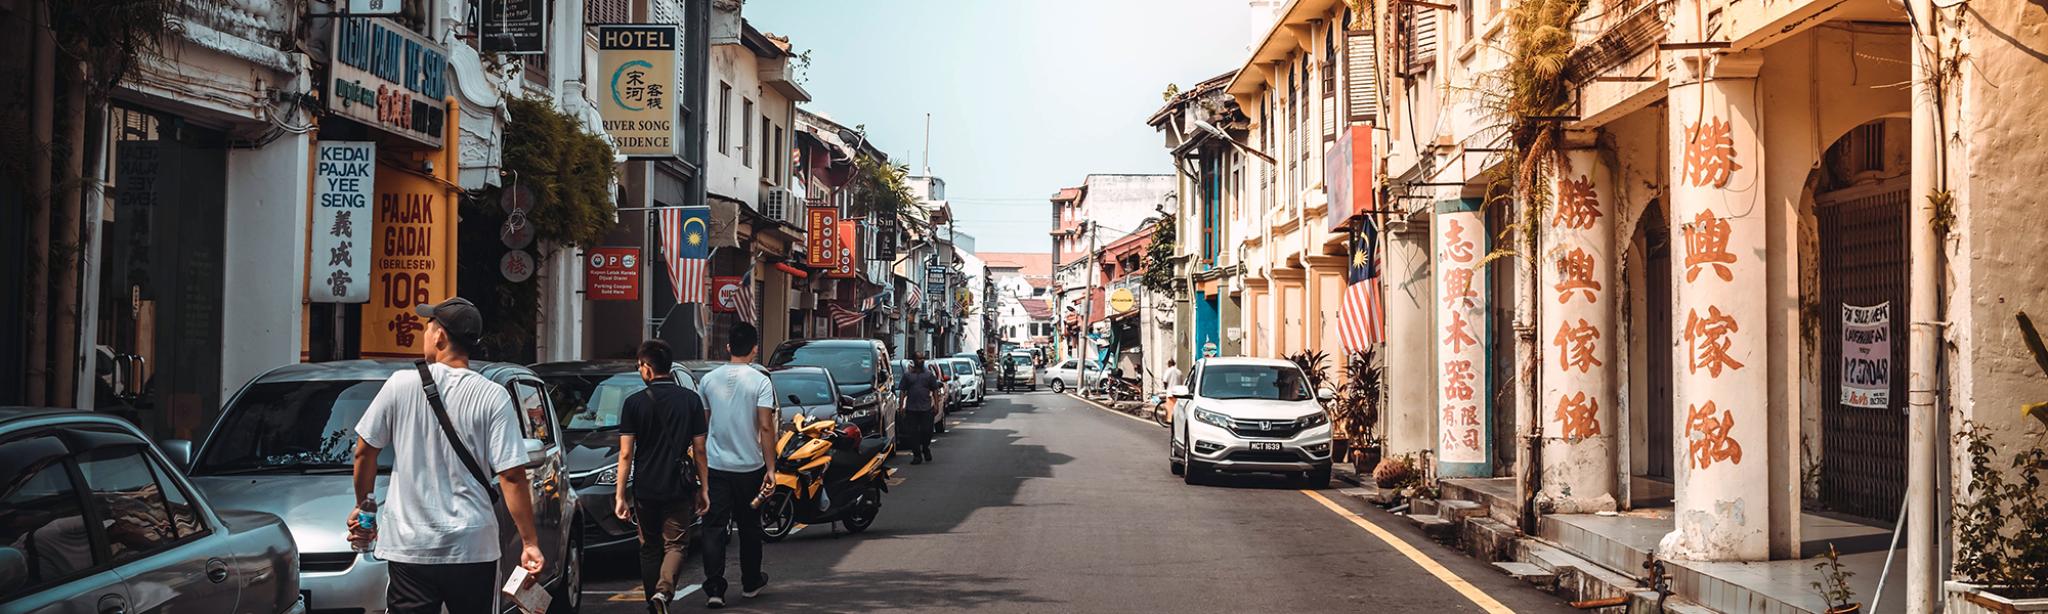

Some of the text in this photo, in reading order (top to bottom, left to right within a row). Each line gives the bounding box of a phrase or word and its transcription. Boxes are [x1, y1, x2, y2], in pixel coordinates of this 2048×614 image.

[605, 31, 670, 48] HOTEL
[337, 17, 371, 72] KEDAI
[370, 23, 403, 85] PAJAK
[404, 38, 423, 93] YEE
[422, 47, 447, 102] SENG
[625, 70, 645, 102] 宋河
[603, 120, 670, 131] RIVER SONG
[321, 147, 369, 161] KEDAI
[611, 137, 670, 148] SIDENCE
[319, 162, 369, 177] PAJAK
[328, 178, 359, 193] YEE
[321, 194, 365, 208] SENG
[381, 193, 433, 224] PAJAK
[327, 210, 353, 297] 義成當
[384, 226, 431, 257] GADAI
[379, 259, 435, 271] (BERLESEN)
[381, 272, 430, 309] 106
[1442, 218, 1477, 401] 志興木器
[388, 311, 425, 348] 當
